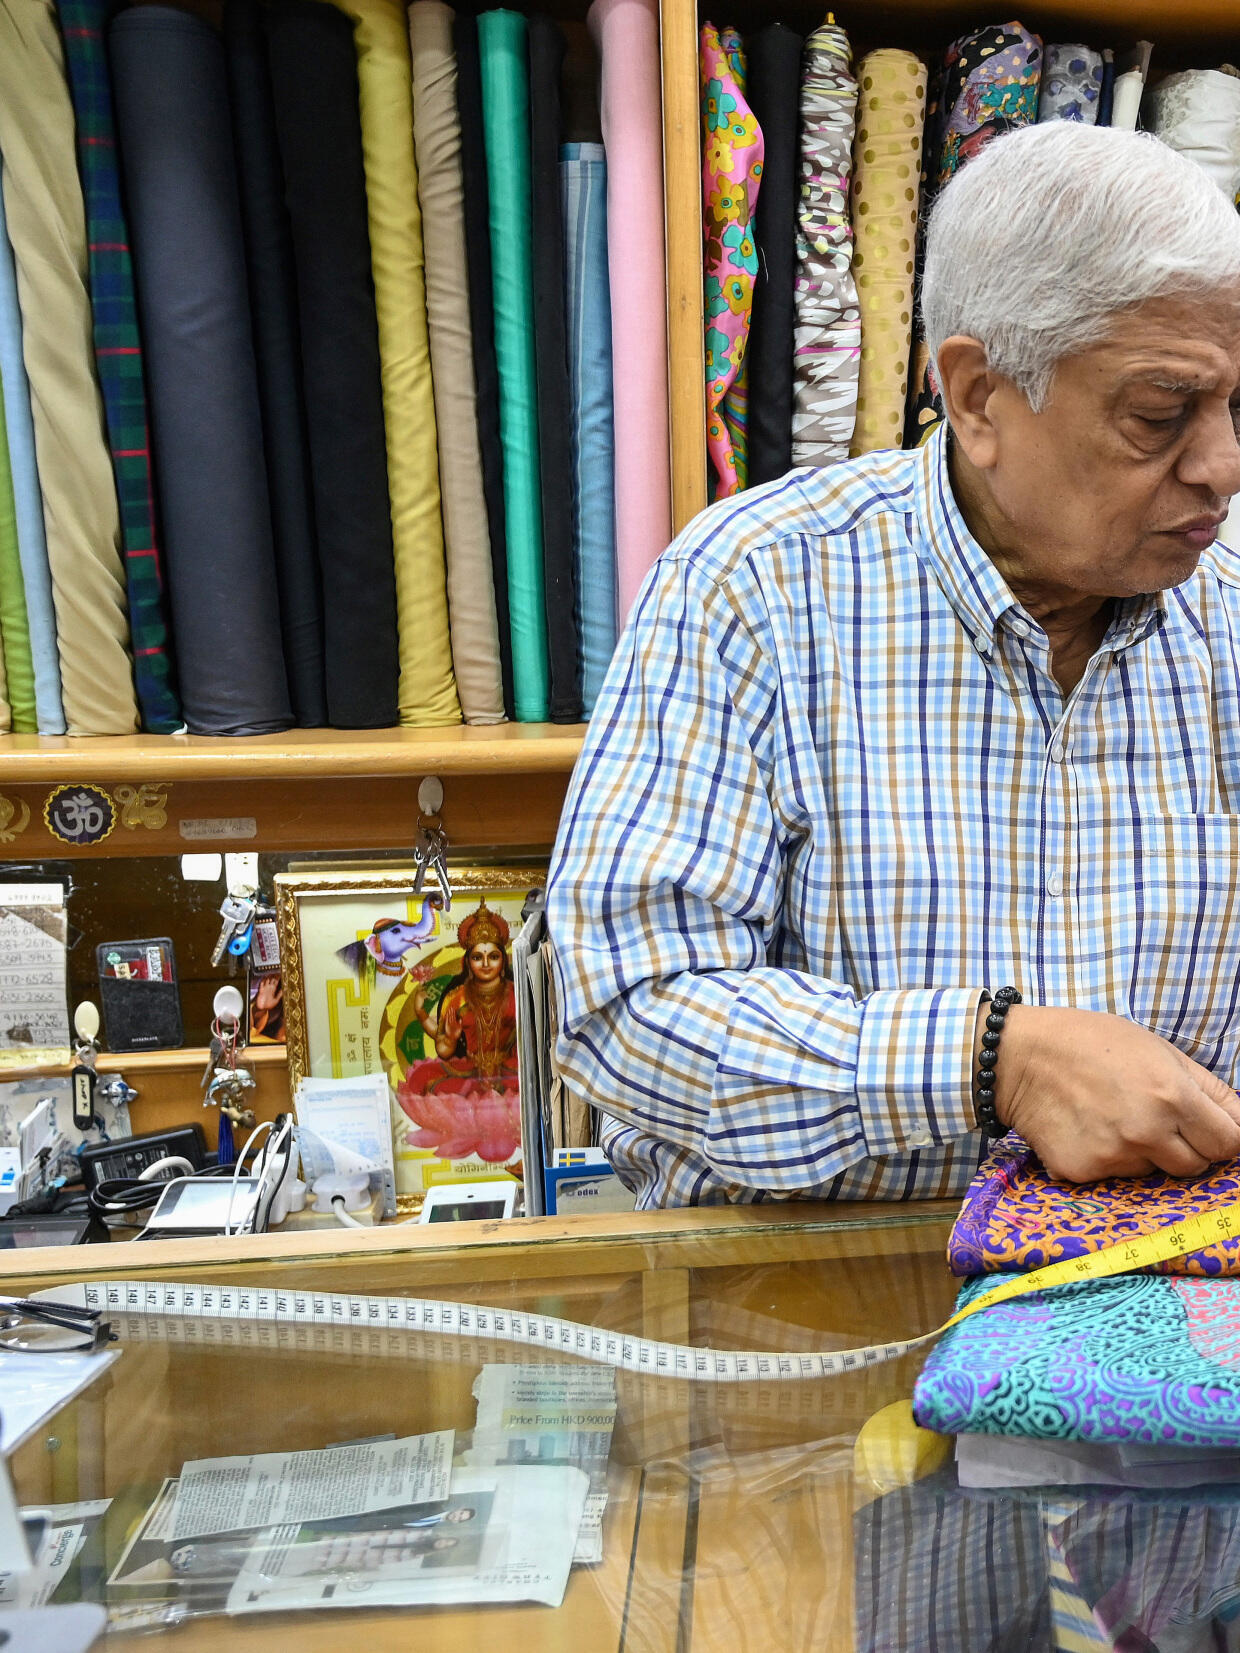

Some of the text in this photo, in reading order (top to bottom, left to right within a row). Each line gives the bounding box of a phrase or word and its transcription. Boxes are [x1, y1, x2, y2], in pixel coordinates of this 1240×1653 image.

[1217, 1217, 1232, 1230] 35
[1170, 1233, 1185, 1245] 36
[1125, 1249, 1139, 1261] 37
[1075, 1262, 1092, 1272] 38
[87, 1289, 98, 1304] 150
[108, 1288, 118, 1303] 149
[128, 1289, 137, 1304] 148
[148, 1290, 156, 1305] 147
[165, 1291, 175, 1306] 146
[184, 1292, 194, 1307] 145
[203, 1293, 212, 1308] 144
[221, 1294, 231, 1309] 143
[240, 1295, 249, 1310] 142
[259, 1296, 267, 1310] 141
[277, 1297, 287, 1312] 140
[296, 1298, 305, 1313] 139
[314, 1300, 324, 1314] 138
[332, 1301, 342, 1316] 137
[351, 1303, 360, 1317] 136
[369, 1304, 378, 1318] 135
[388, 1305, 398, 1319] 134
[406, 1307, 416, 1321] 133
[424, 1308, 434, 1323] 132
[442, 1310, 452, 1324] 131
[460, 1311, 470, 1327] 130
[478, 1314, 487, 1329] 129
[510, 1415, 533, 1425] Price
[535, 1415, 559, 1425] From
[562, 1415, 585, 1425] HKD
